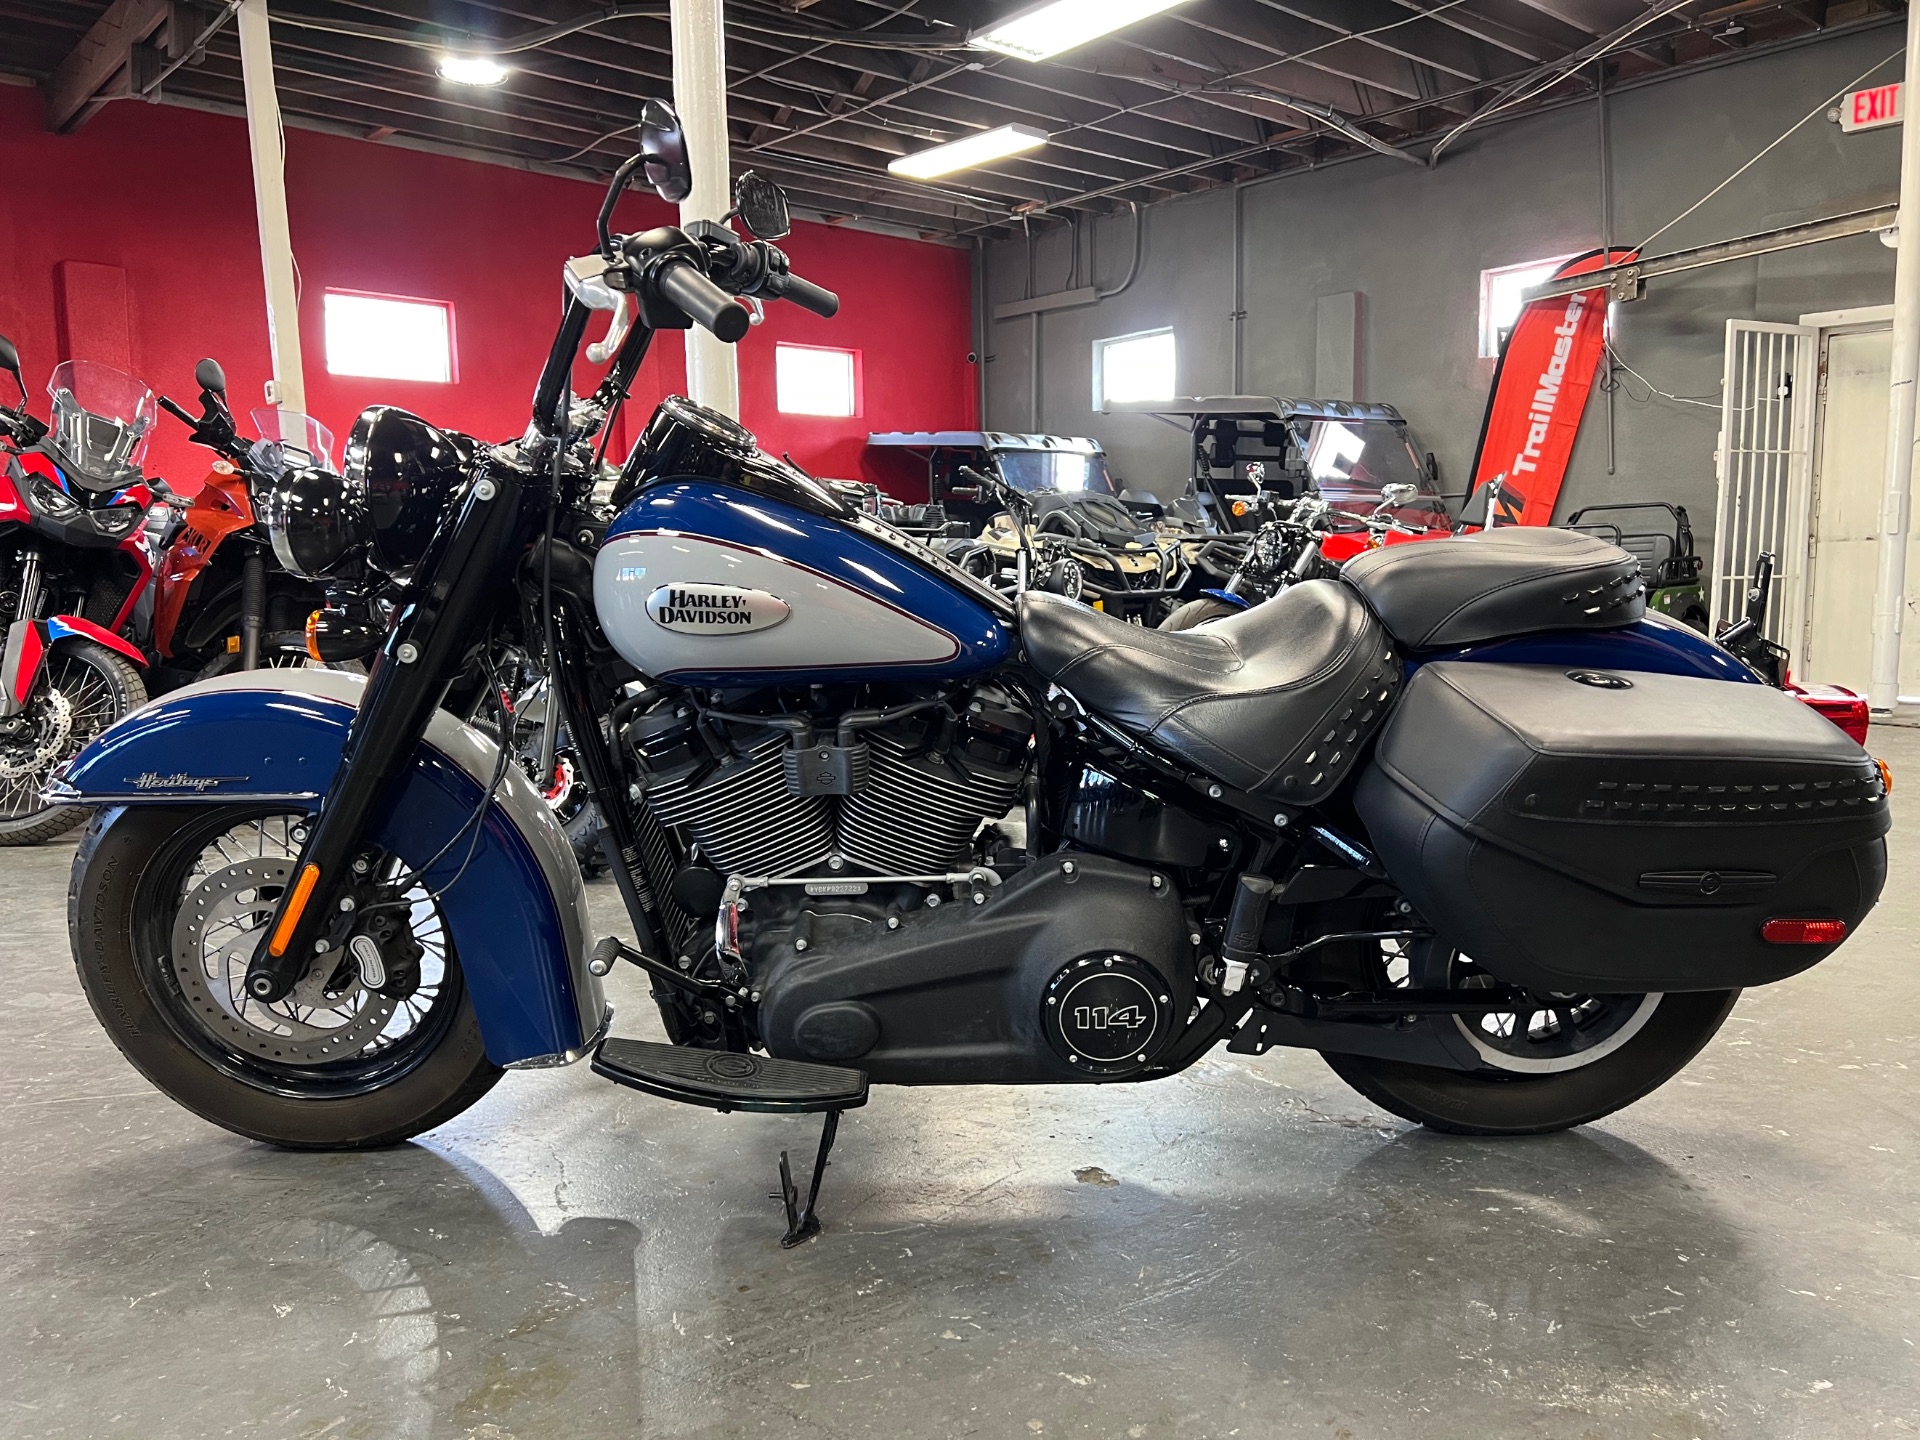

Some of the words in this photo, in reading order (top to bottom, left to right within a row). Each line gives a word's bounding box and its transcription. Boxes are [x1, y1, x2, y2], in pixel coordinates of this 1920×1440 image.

[1853, 86, 1899, 124] EXIT
[1512, 292, 1588, 476] TrailMaster
[659, 606, 752, 624] DAVIDSON
[136, 772, 219, 792] Heritage
[1074, 1005, 1147, 1029] 114
